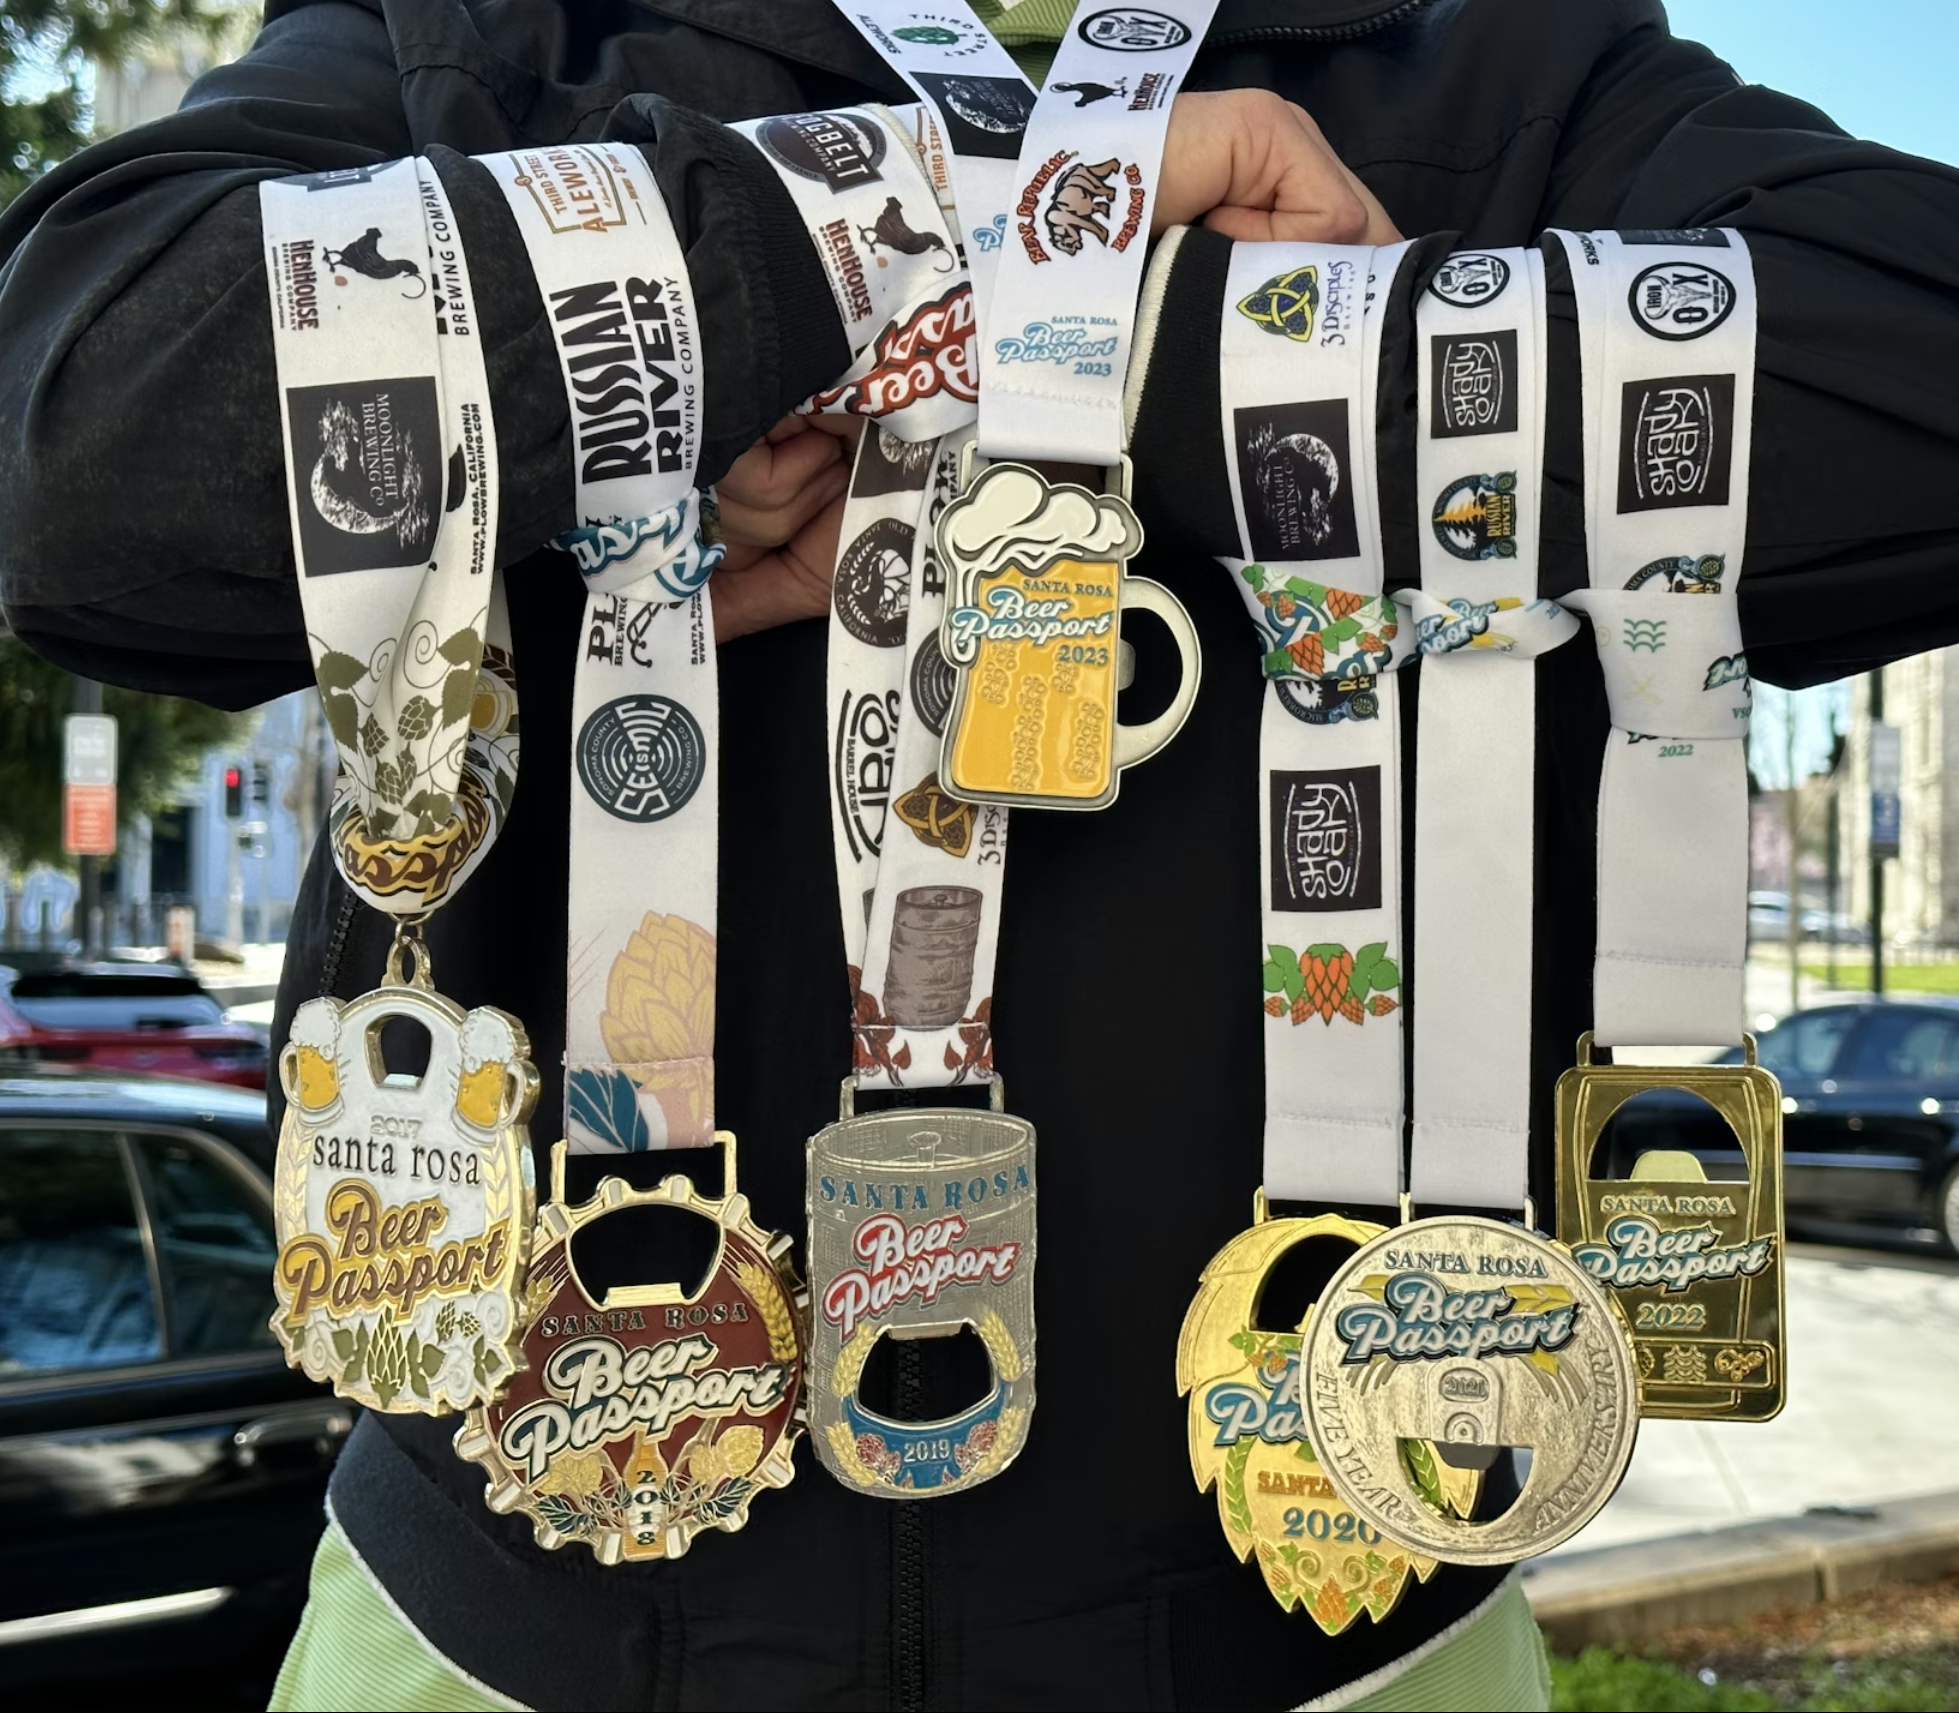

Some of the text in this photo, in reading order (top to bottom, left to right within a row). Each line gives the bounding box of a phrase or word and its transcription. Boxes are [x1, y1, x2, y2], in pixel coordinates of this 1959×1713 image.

[932, 154, 948, 192] THIRD
[419, 180, 451, 243] COMPANY
[540, 181, 567, 215] THIRD
[289, 240, 319, 331] HENHOUSE
[440, 250, 470, 336] BREWING
[825, 217, 873, 322] HENHOUSE
[1051, 316, 1118, 326] SANTA ROSA
[1647, 284, 1662, 309] IRON
[995, 336, 1119, 365] Passport
[1023, 322, 1088, 347] Beer
[1320, 333, 1346, 348] 3
[549, 280, 653, 484] RUSSIAN
[625, 277, 683, 473] RIVER
[664, 276, 695, 470] BREWING COMPANY
[1074, 362, 1112, 376] 2023
[362, 402, 382, 482] BREWING
[376, 393, 399, 499] MOONLIGHT
[461, 403, 478, 483] CALIFORNIA
[1285, 477, 1300, 544] BREWING
[470, 530, 480, 575] SANTA
[988, 586, 1071, 620] Beer
[1023, 579, 1114, 598] SANTA ROSA
[837, 595, 879, 644] CALIFORNIA
[951, 609, 1115, 646] Passport
[691, 624, 700, 665] SANTA
[1059, 645, 1109, 666] 2023
[925, 649, 940, 717] SONOMA COUN
[591, 717, 615, 797] SONOMA COUNTY
[676, 742, 692, 789] BREWING
[1658, 744, 1694, 758] 2022
[846, 738, 860, 815] BARREL HOUSE
[370, 1115, 424, 1139] 2017
[313, 1135, 480, 1185] santa rosa
[819, 1164, 1030, 1210] SANTA ROSA
[1601, 1196, 1736, 1215] SANTA ROSA
[328, 1181, 445, 1261] Beer
[855, 1213, 968, 1276] Beer
[1607, 1215, 1719, 1259] Beer
[280, 1222, 509, 1320] Passport
[1385, 1250, 1547, 1278] SANTA ROSA
[1573, 1238, 1775, 1293] Passport
[823, 1243, 1021, 1343] Passport
[1386, 1273, 1515, 1323] Beer
[1636, 1304, 1706, 1329] 2022
[541, 1303, 748, 1338] SANTA ROSA
[1337, 1303, 1579, 1364] Passport
[545, 1334, 716, 1410] Beer
[502, 1365, 788, 1482] Passport
[1316, 1371, 1405, 1520] FIVE YEAR
[904, 1439, 950, 1463] 2019
[635, 1469, 658, 1547] 2018
[1257, 1470, 1337, 1499] SANTA
[1282, 1507, 1384, 1545] 2020
